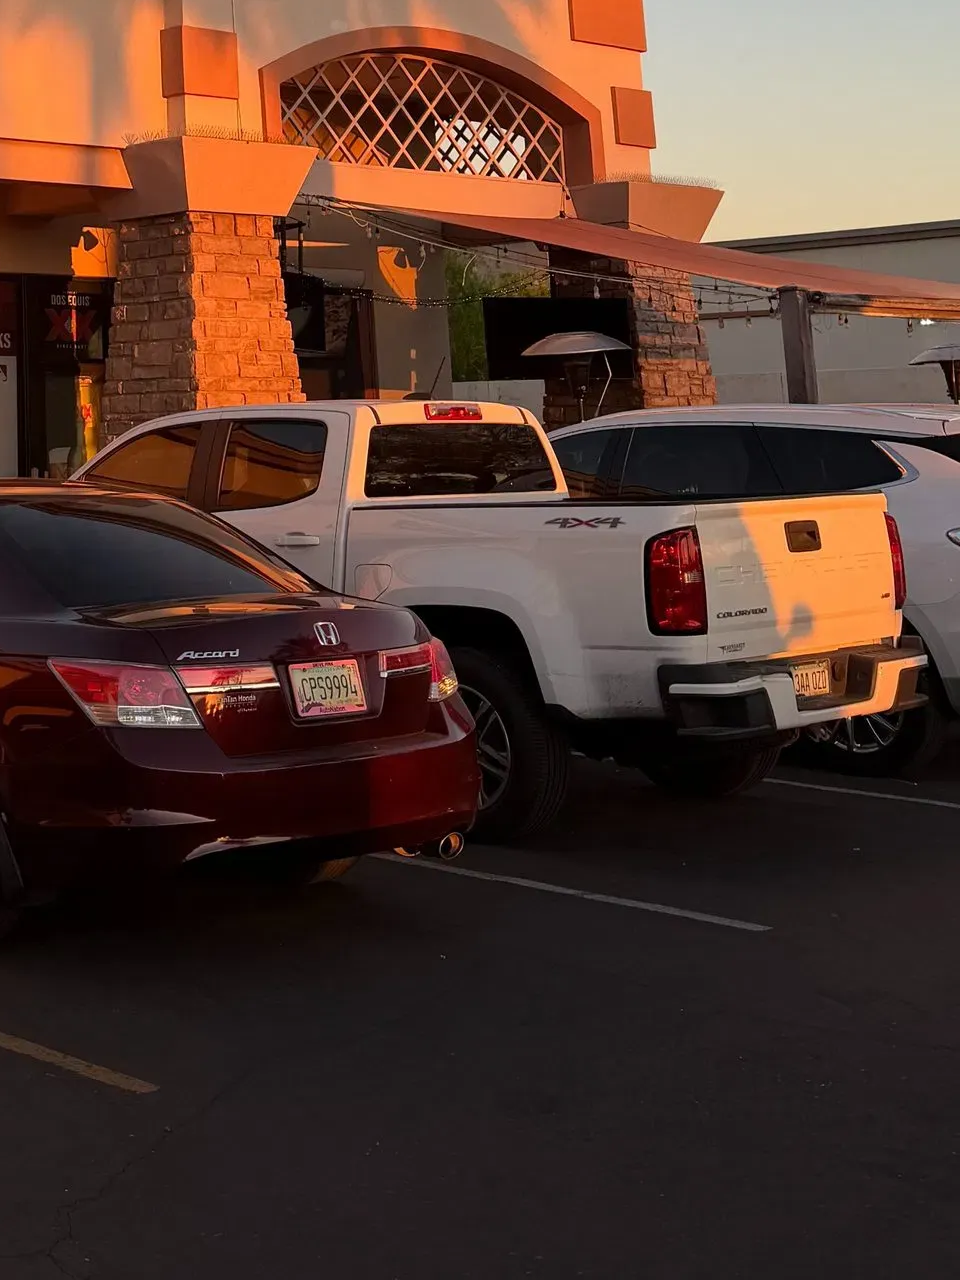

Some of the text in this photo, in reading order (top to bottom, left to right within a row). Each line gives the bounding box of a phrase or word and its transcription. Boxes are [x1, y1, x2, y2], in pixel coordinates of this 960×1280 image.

[50, 294, 91, 307] DOS EQUIS
[716, 607, 768, 619] COLORADO
[176, 649, 240, 661] Accord
[301, 674, 358, 701] CPS9994
